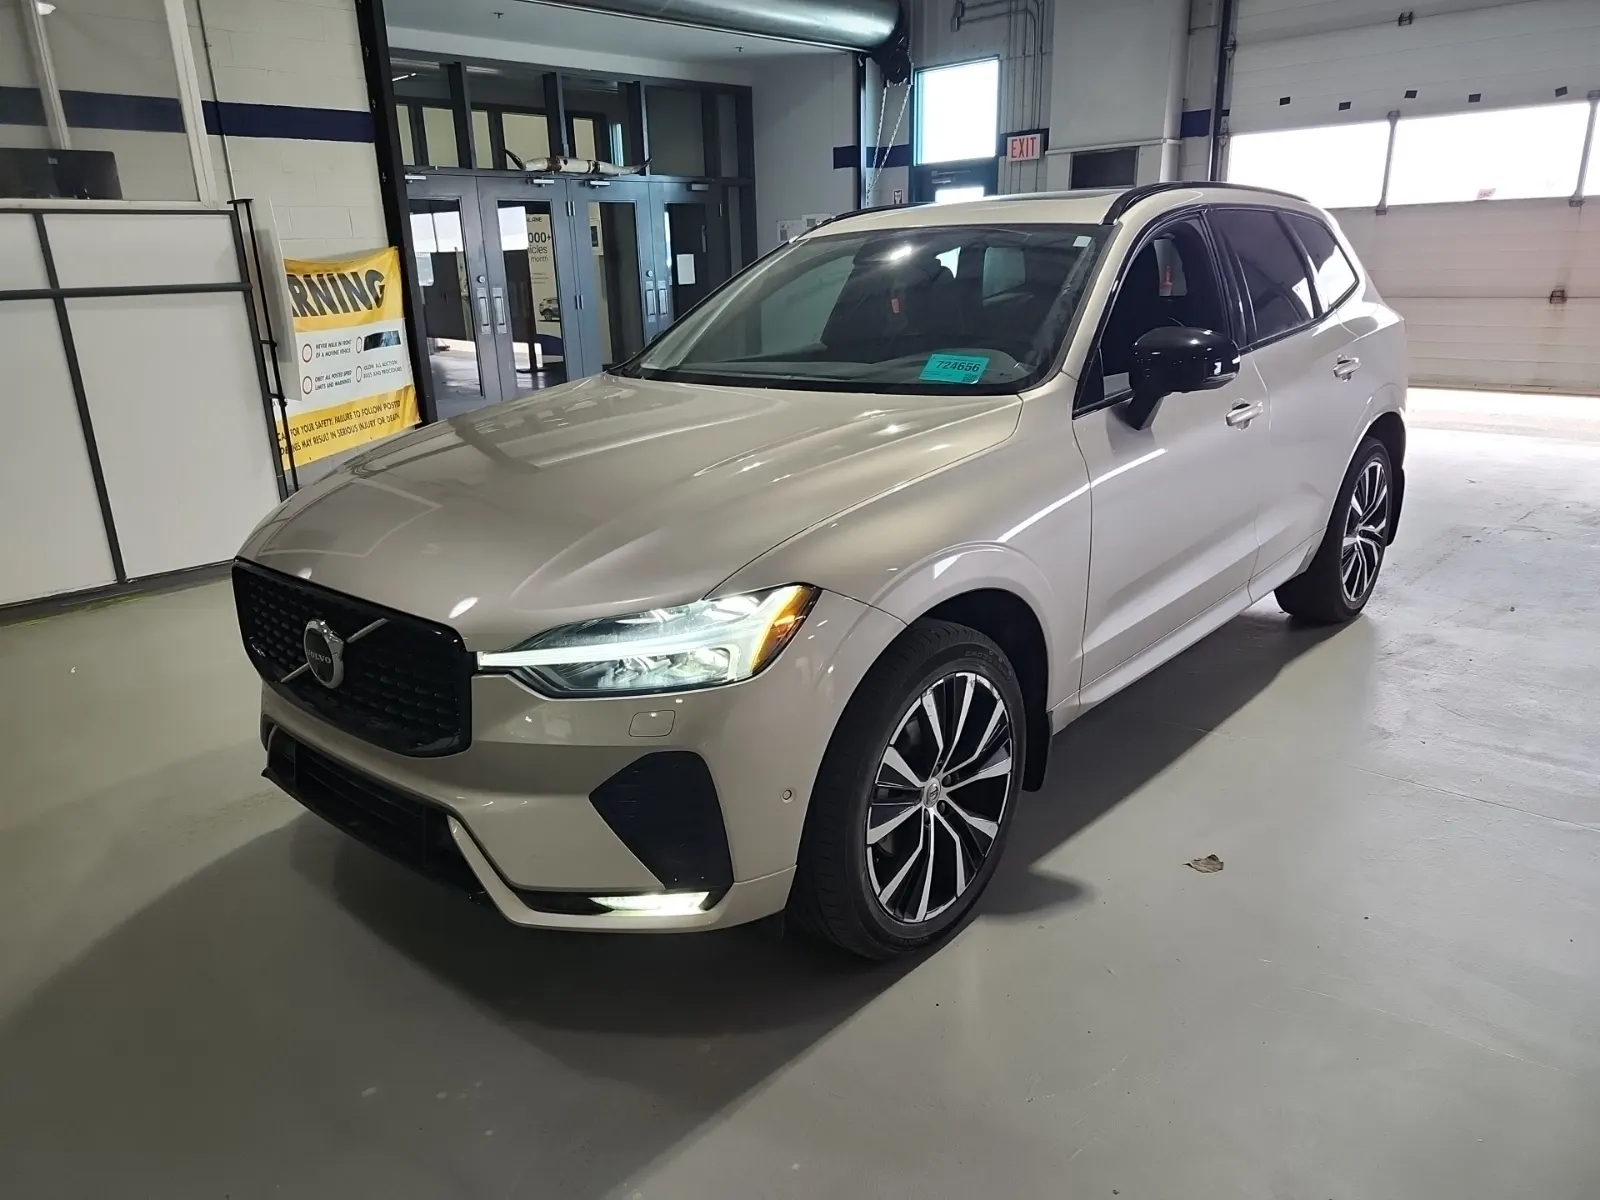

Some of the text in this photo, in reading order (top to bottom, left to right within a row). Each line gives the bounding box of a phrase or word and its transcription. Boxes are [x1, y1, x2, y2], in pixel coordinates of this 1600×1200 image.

[1012, 137, 1036, 158] EXIT
[936, 361, 980, 372] 724656
[301, 423, 315, 433] YOUR
[334, 412, 353, 424] FAILURE
[353, 410, 360, 418] TO
[362, 404, 382, 416] FOLLOW
[302, 438, 312, 448] MAY
[313, 432, 329, 444] RESULT
[337, 424, 358, 437] SERIOUS
[359, 419, 376, 430] INJURY
[378, 416, 386, 425] OR
